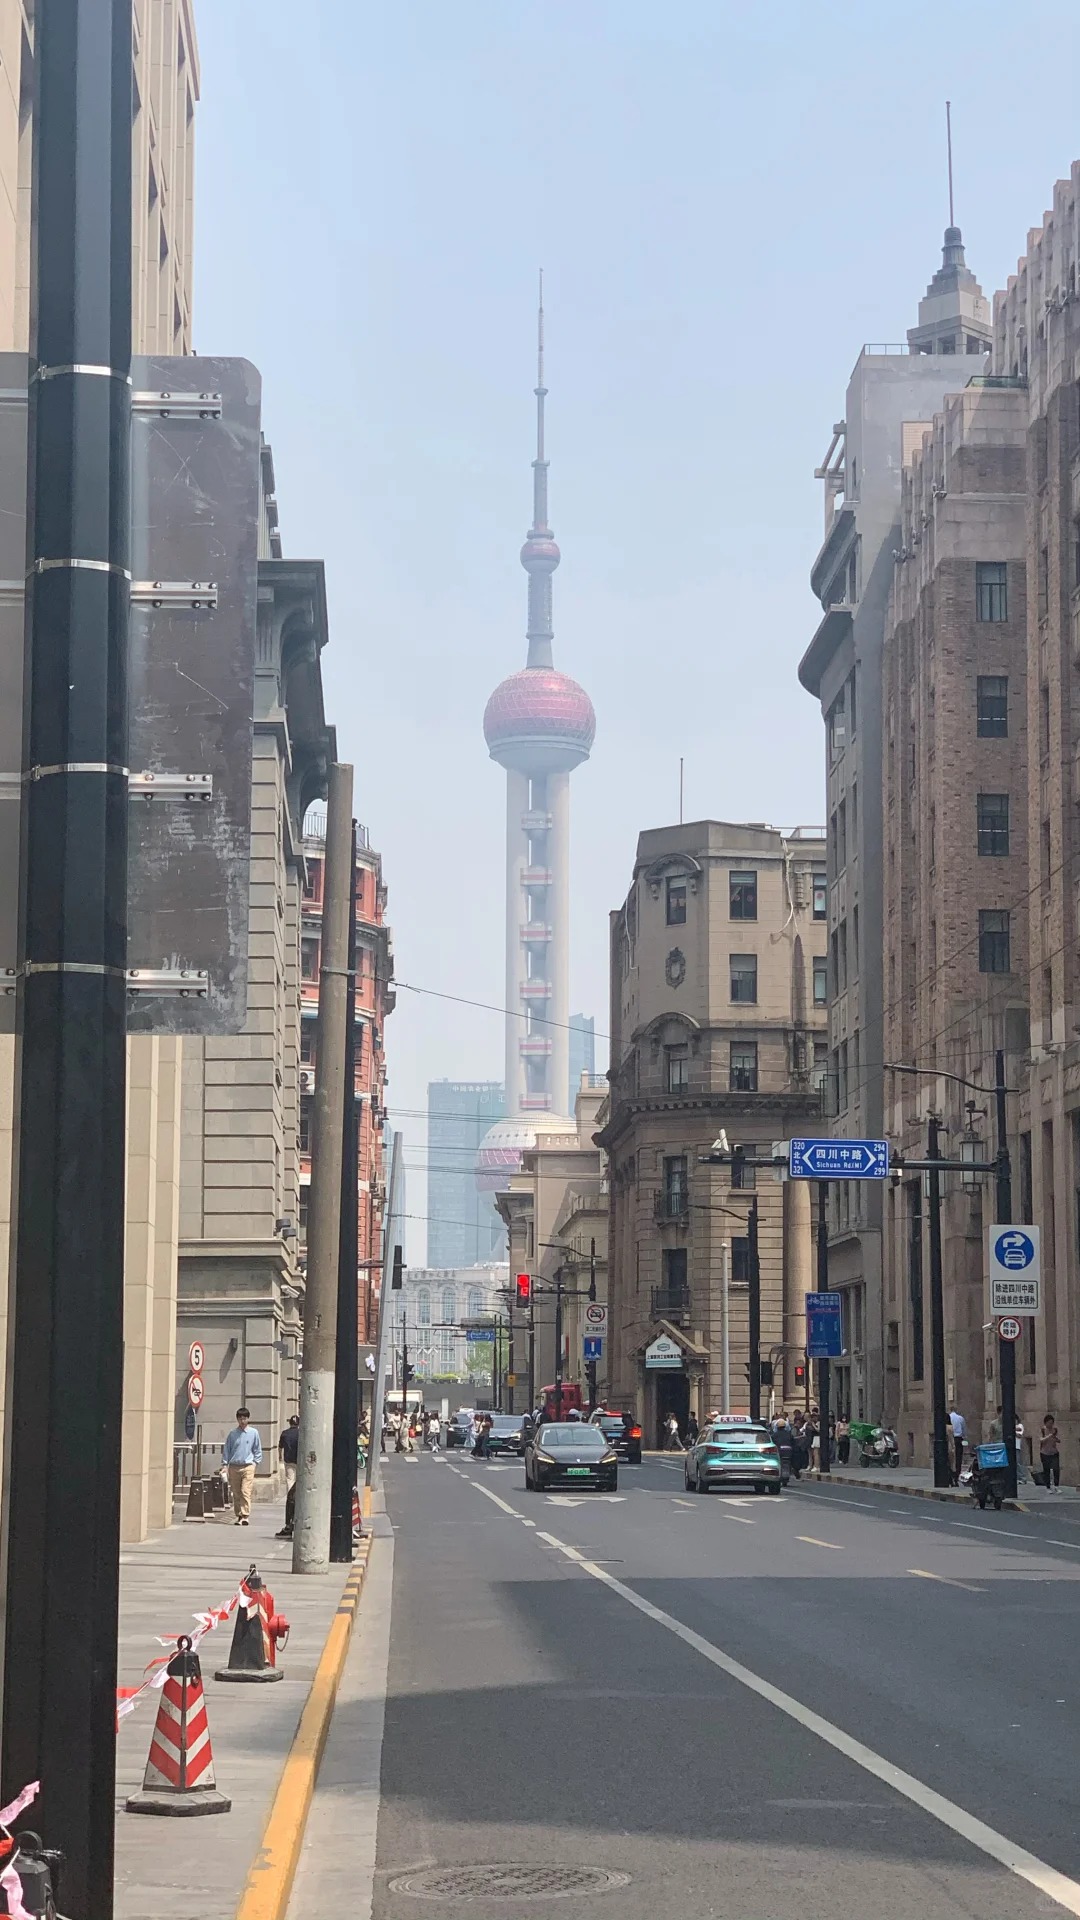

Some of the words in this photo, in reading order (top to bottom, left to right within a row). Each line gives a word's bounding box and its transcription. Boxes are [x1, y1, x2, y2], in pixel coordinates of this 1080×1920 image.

[793, 1142, 805, 1150] 320
[874, 1143, 885, 1151] 294
[793, 1151, 801, 1159] 北
[816, 1149, 862, 1160] 四川中路
[877, 1153, 885, 1161] 南
[793, 1166, 804, 1174] 321
[874, 1167, 885, 1175] 299
[995, 1283, 1035, 1294] 除进四川中路
[995, 1295, 1036, 1305] 沿线单位车辆外
[195, 1350, 200, 1366] 5
